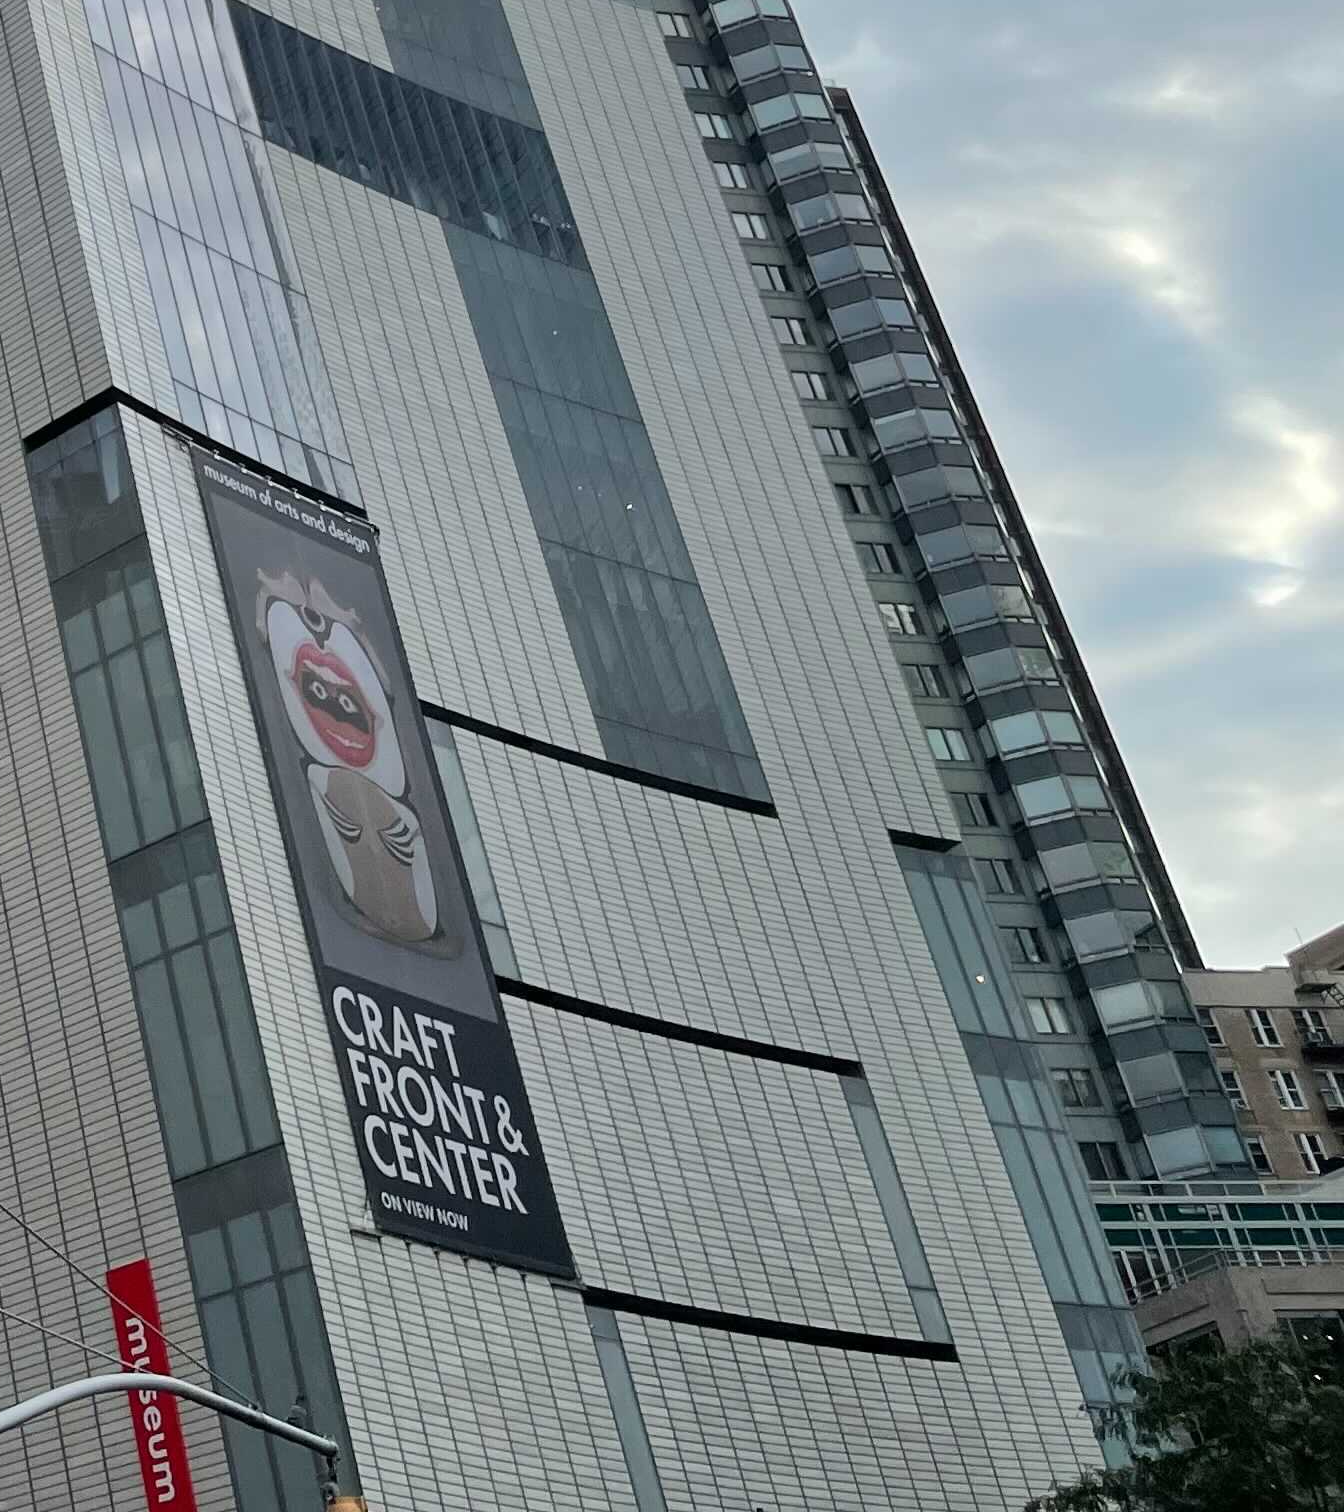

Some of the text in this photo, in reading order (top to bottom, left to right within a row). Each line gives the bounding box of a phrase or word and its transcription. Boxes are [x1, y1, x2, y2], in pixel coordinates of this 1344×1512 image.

[204, 464, 371, 553] museum of arts and design
[332, 986, 460, 1078] CRAFT
[346, 1047, 529, 1156] FRONT &
[364, 1114, 529, 1215] CENTER
[381, 1191, 469, 1232] ON VIEW NOW
